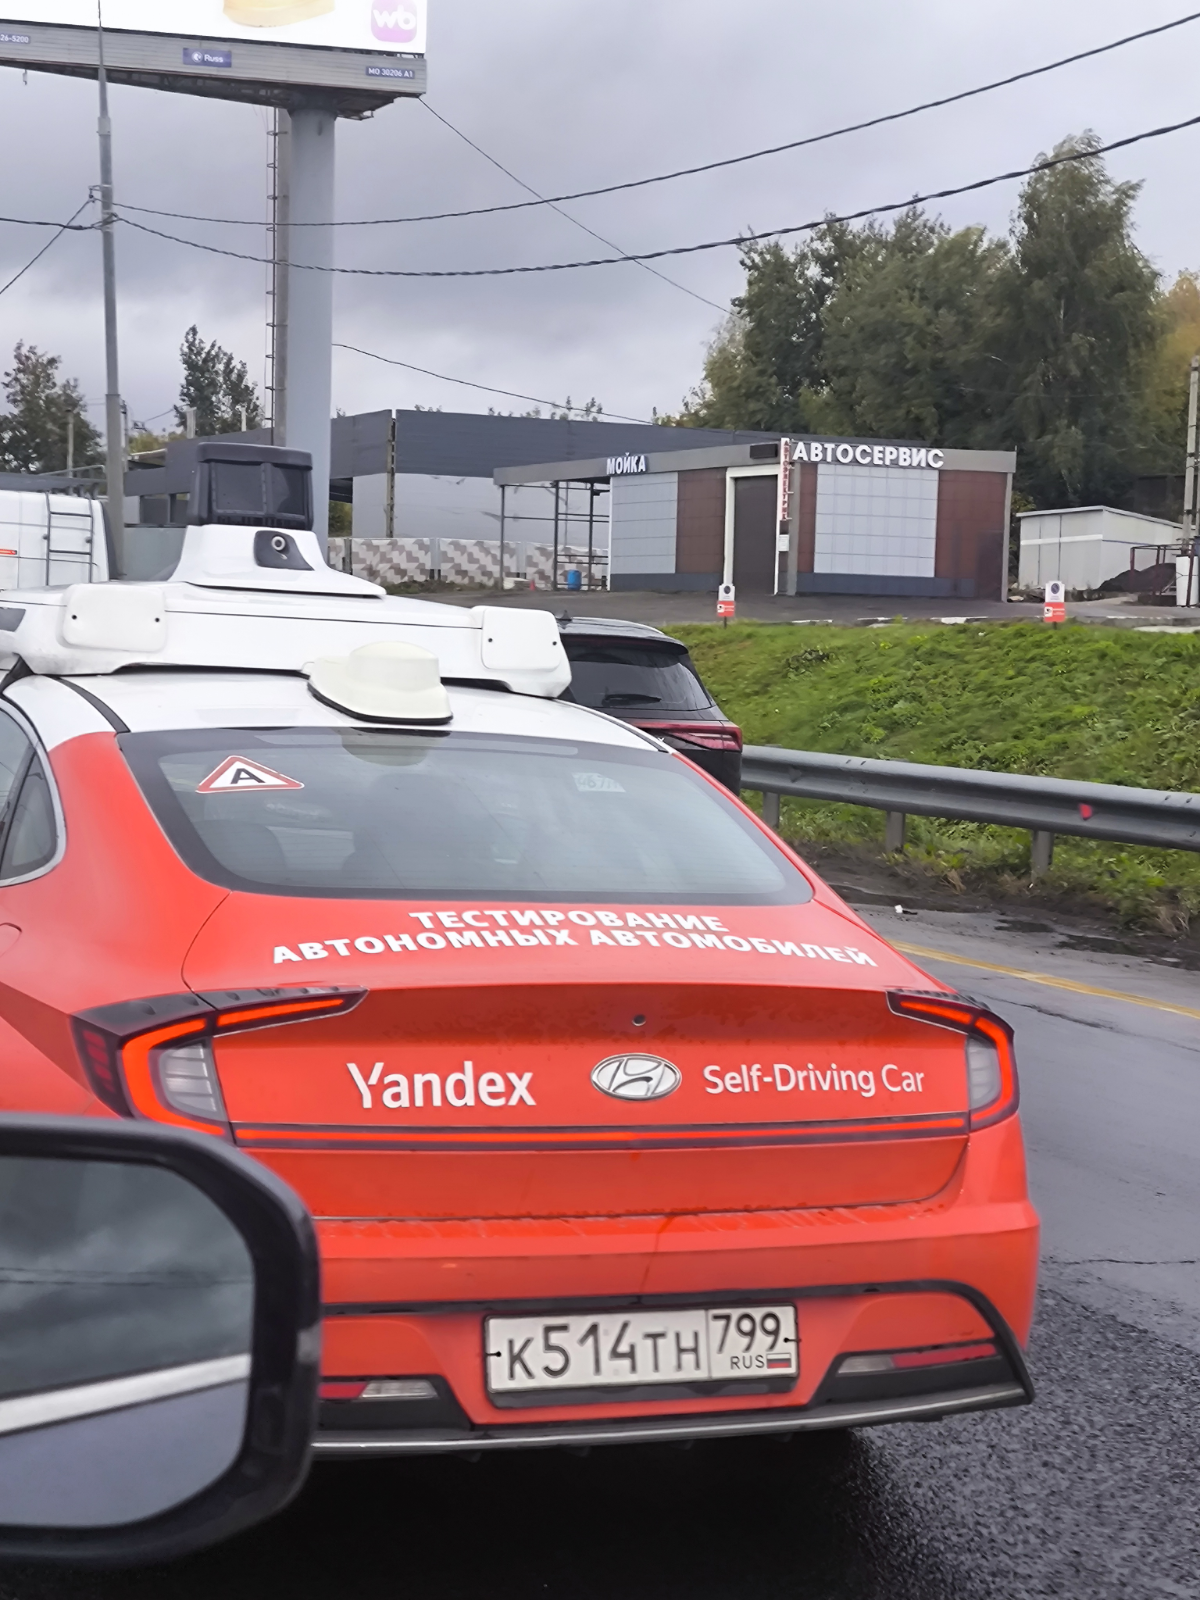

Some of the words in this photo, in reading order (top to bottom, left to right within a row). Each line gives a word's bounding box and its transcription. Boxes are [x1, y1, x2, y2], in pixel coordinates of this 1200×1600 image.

[372, 4, 417, 30] wb
[204, 54, 224, 63] Russ
[606, 452, 647, 475] МОЙКА
[792, 441, 945, 469] АВТОСЕРВИС
[230, 768, 266, 785] А
[408, 909, 730, 932] ТЕСТИРОВАНИЕ
[272, 929, 578, 964] АВТОНОМНЫХ
[590, 929, 877, 967] АВТОМОБИЛЕЙ
[346, 1060, 536, 1108] Yandex
[703, 1063, 876, 1098] Self-Driving
[881, 1063, 924, 1092] Car
[508, 1320, 701, 1380] К514ТН
[711, 1313, 782, 1355] 799
[730, 1354, 766, 1371] RUS
